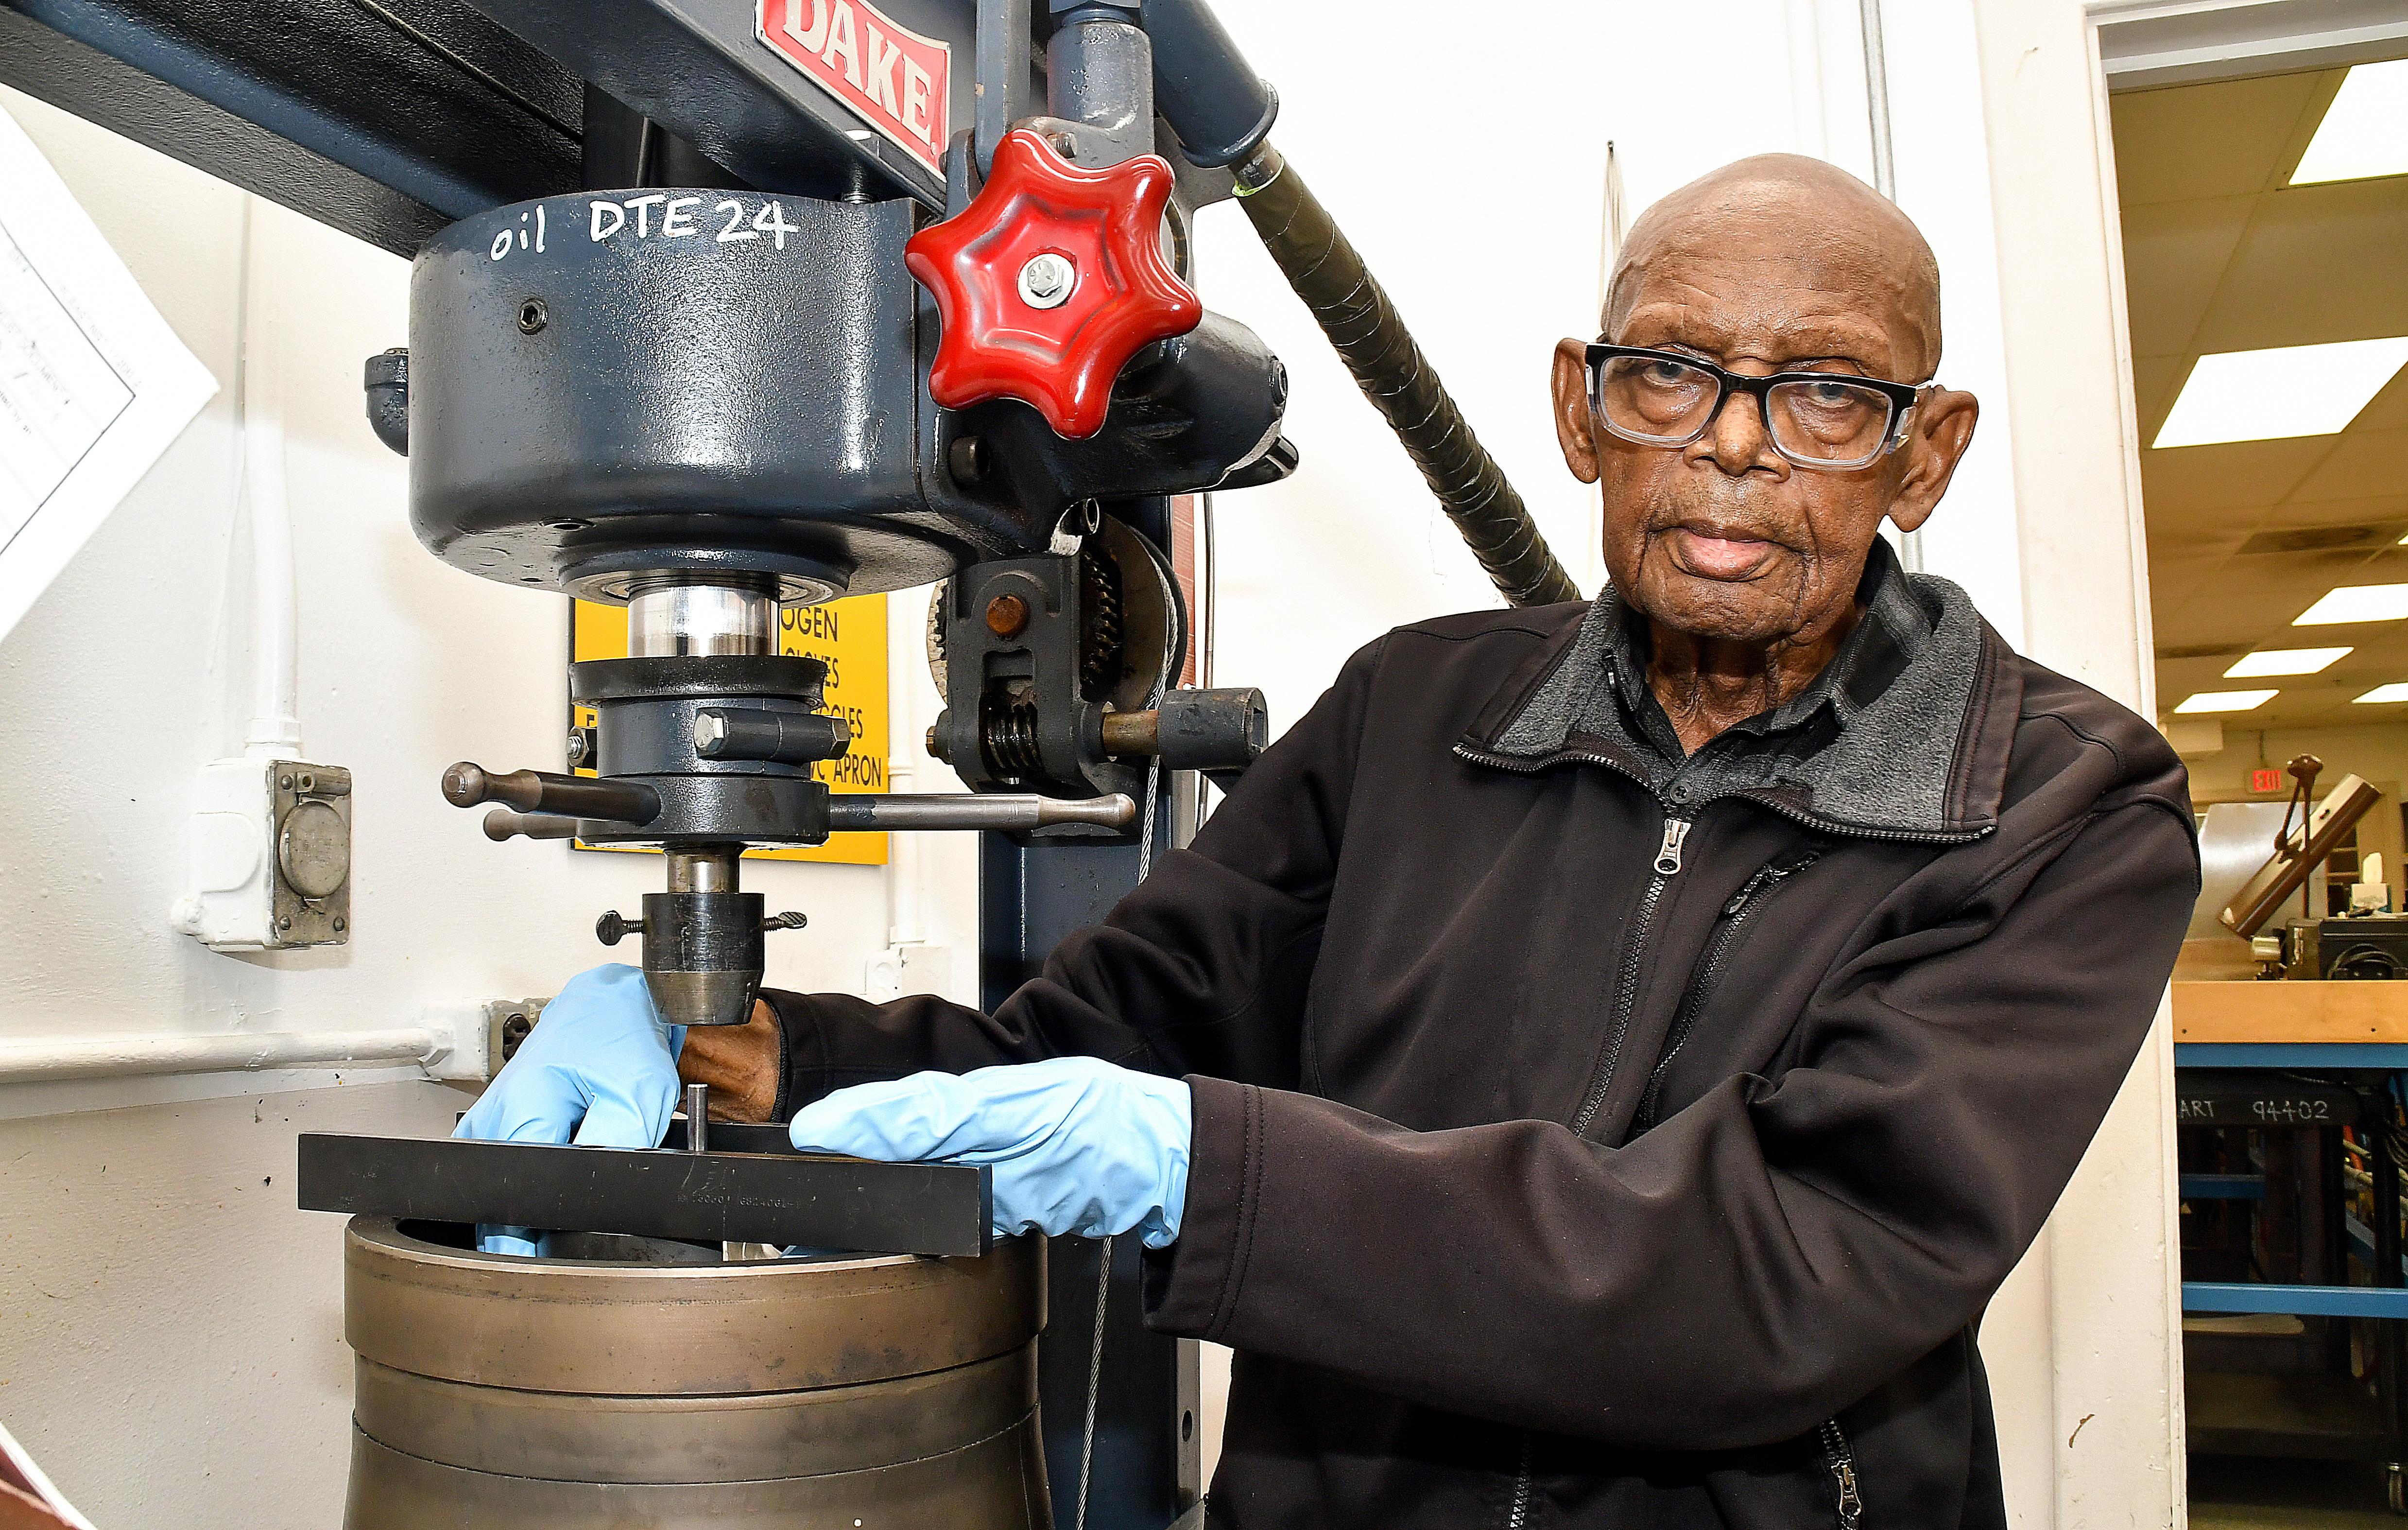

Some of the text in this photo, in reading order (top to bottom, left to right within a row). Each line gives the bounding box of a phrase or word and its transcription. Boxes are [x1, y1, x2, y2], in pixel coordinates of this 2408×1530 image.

[783, 0, 931, 146] DAKE
[490, 194, 799, 261] oil DTE 24
[833, 753, 881, 787] APRON
[2253, 770, 2281, 791] EXIT
[2253, 1100, 2329, 1122] 94402
